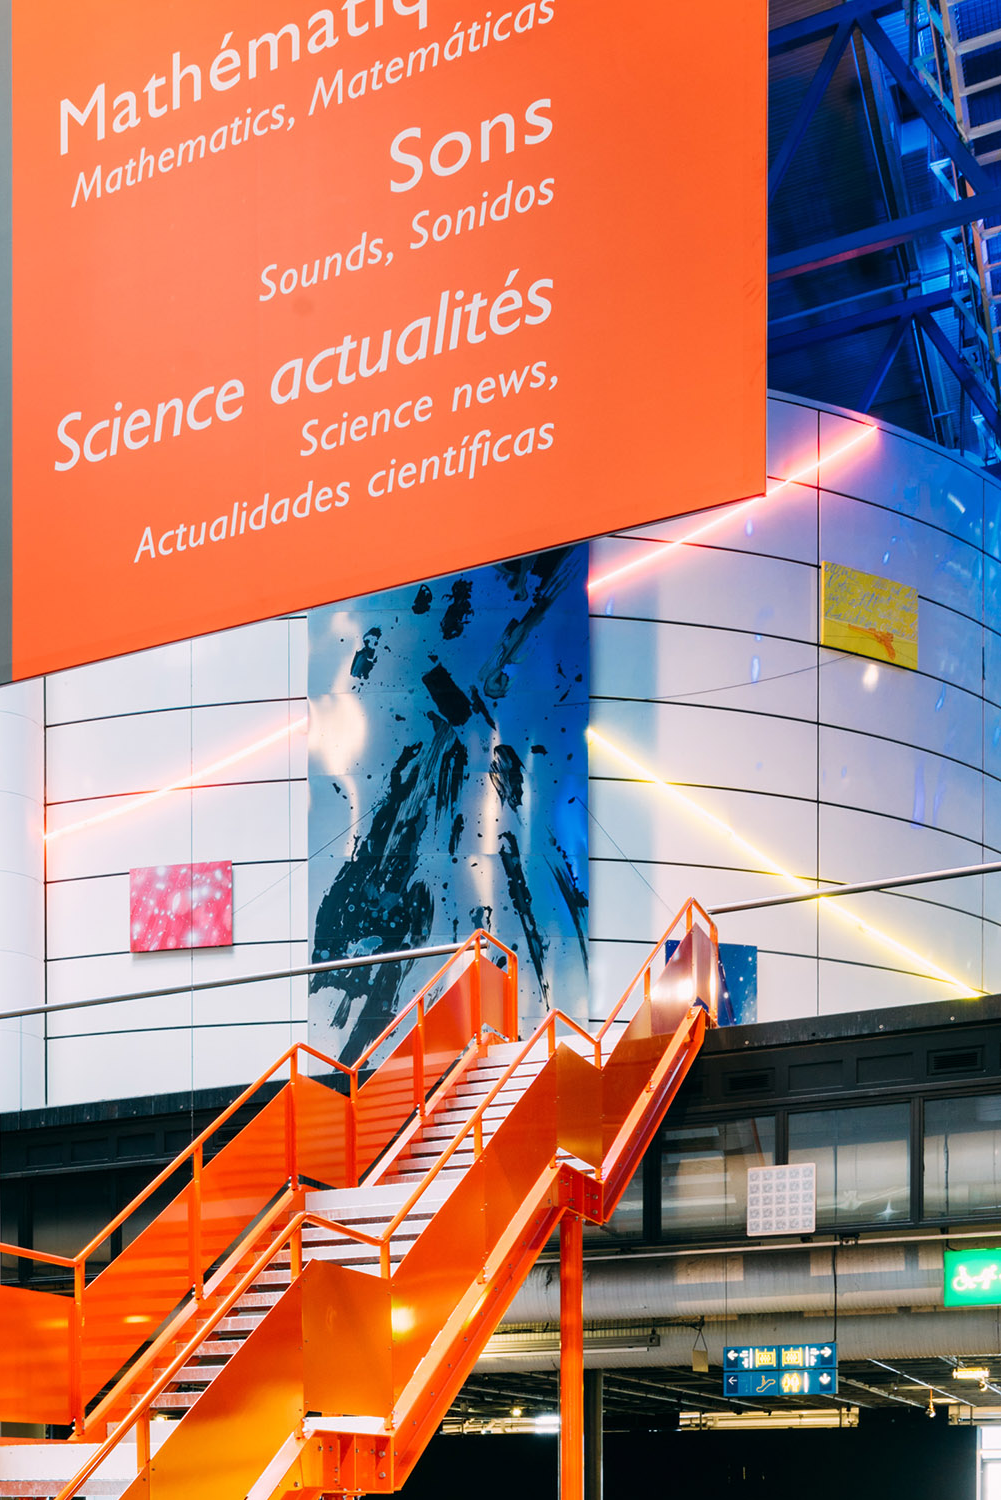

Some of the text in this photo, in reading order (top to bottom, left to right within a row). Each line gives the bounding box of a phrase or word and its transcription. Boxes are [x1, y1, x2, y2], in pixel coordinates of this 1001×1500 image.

[71, 0, 554, 207] Mathematics, Matemáticas
[390, 98, 553, 193] Sons
[259, 177, 555, 302] Sounds, Sonidos
[54, 268, 554, 472] Science actualités
[300, 361, 559, 457] Science news,
[134, 422, 555, 563] Actualidades científicas
